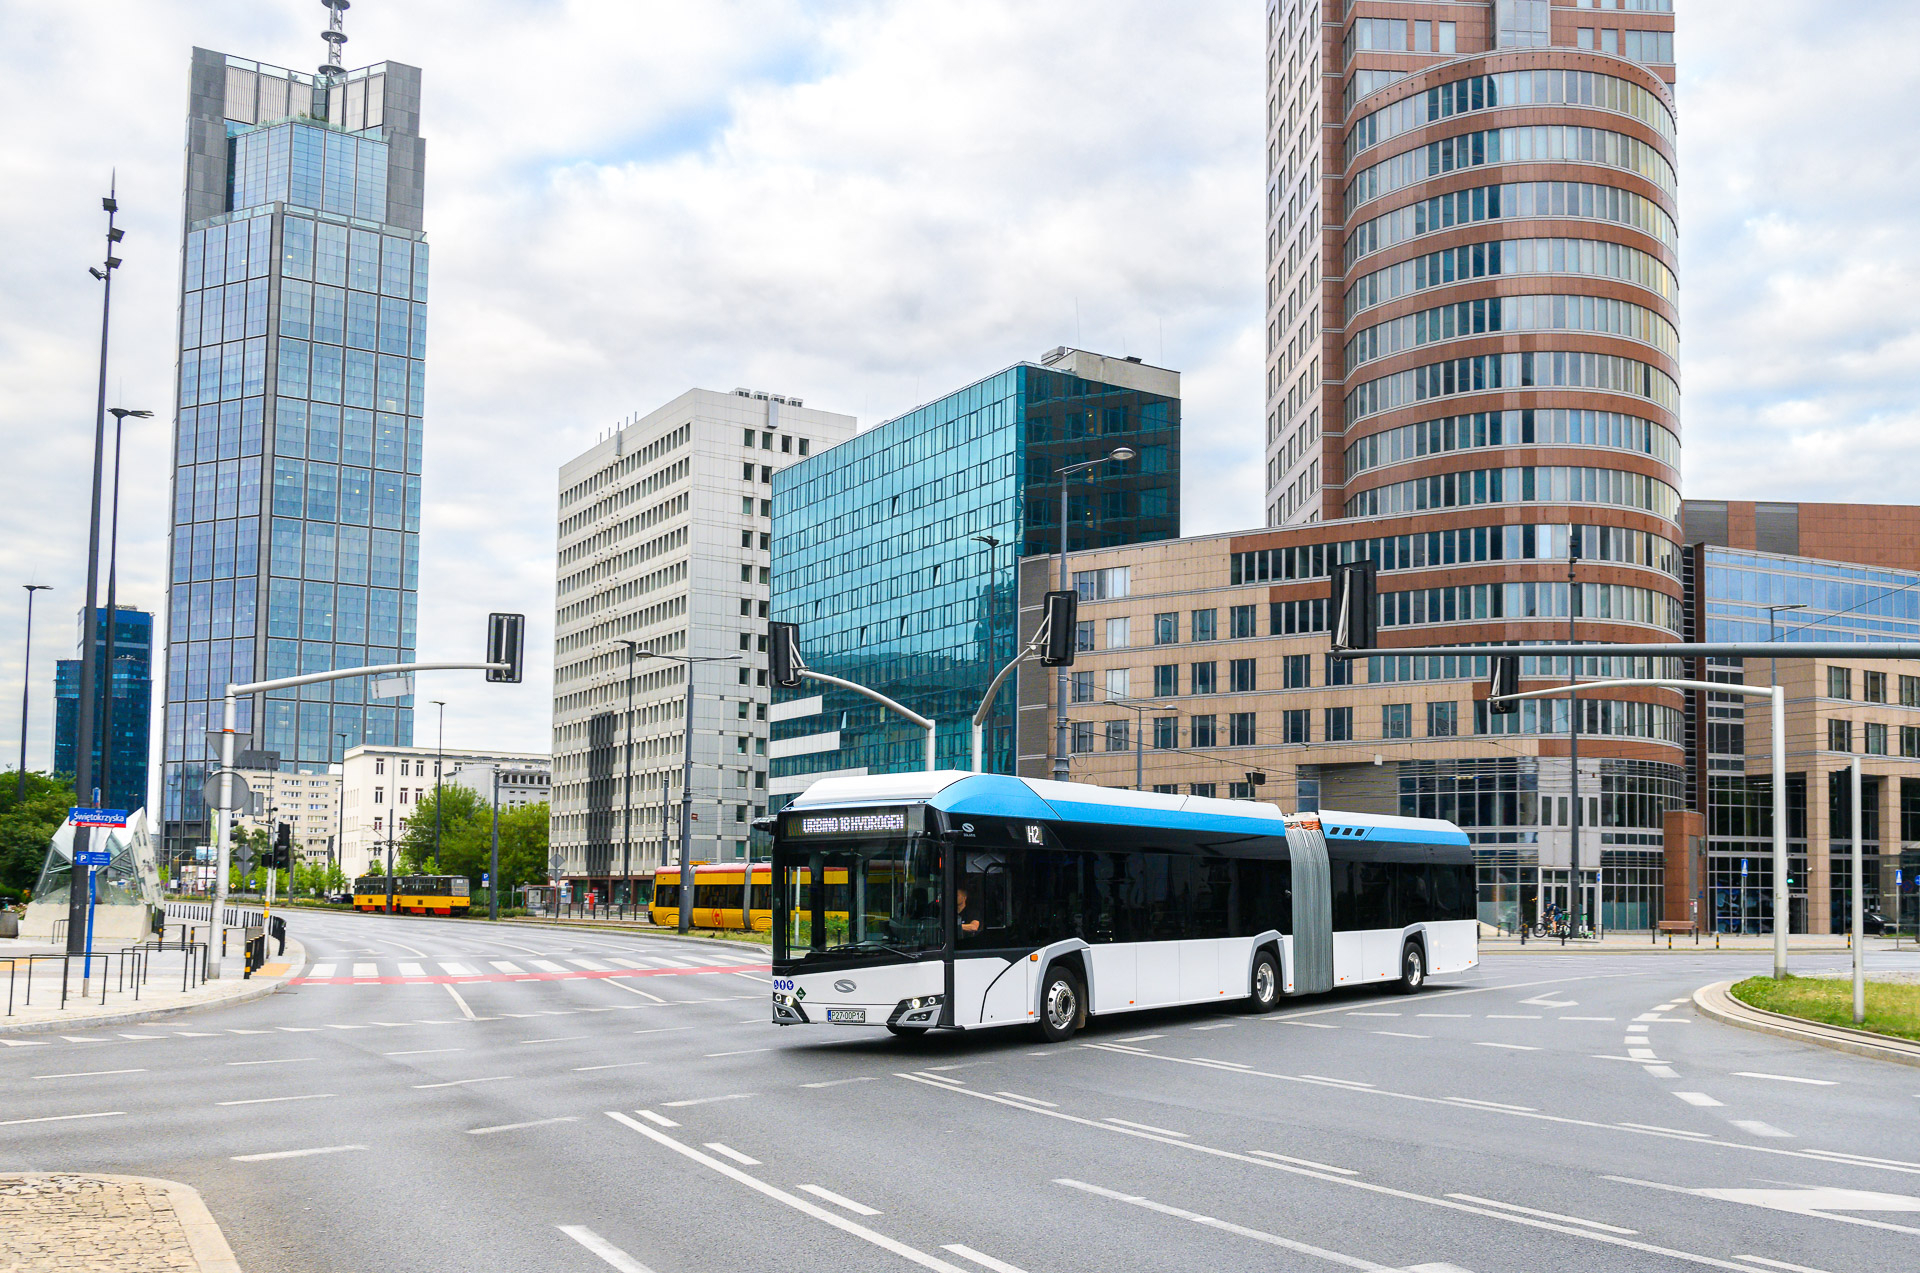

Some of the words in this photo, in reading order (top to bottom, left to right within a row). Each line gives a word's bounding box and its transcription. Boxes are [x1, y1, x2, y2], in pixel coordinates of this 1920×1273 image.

[74, 811, 124, 823] Świętokrzyska
[803, 818, 838, 833] URBINO
[839, 817, 850, 831] 18
[851, 814, 904, 830] HYDROGEN
[1027, 825, 1040, 843] H2
